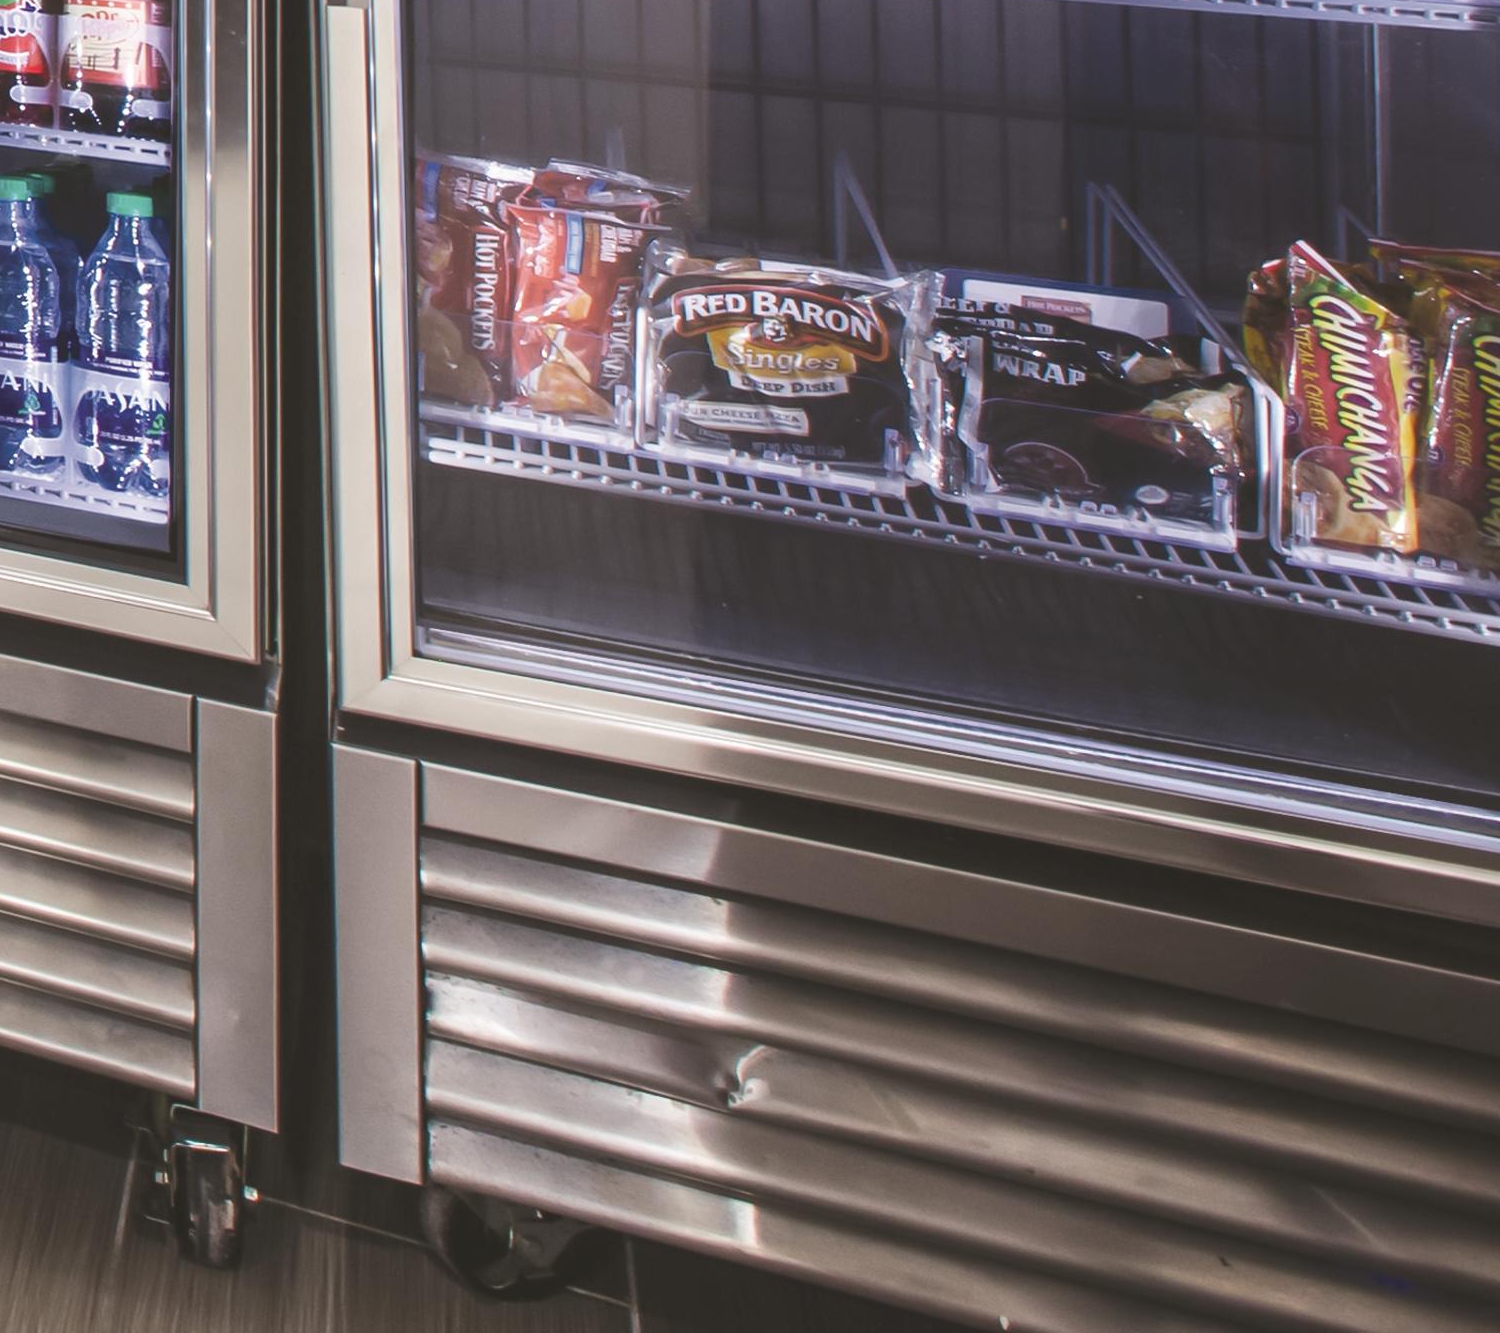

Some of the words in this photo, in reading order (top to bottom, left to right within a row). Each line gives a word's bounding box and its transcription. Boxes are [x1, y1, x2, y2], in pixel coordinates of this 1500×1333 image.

[474, 233, 500, 271] HOT
[470, 271, 500, 351] POCKETS
[680, 291, 747, 323] RED
[751, 290, 876, 344] BARON
[729, 340, 841, 376] Singles
[992, 352, 1087, 386] WRAP
[789, 379, 836, 395] DISH
[1308, 293, 1391, 513] CHIMICHANGA
[711, 408, 760, 420] CHEESE
